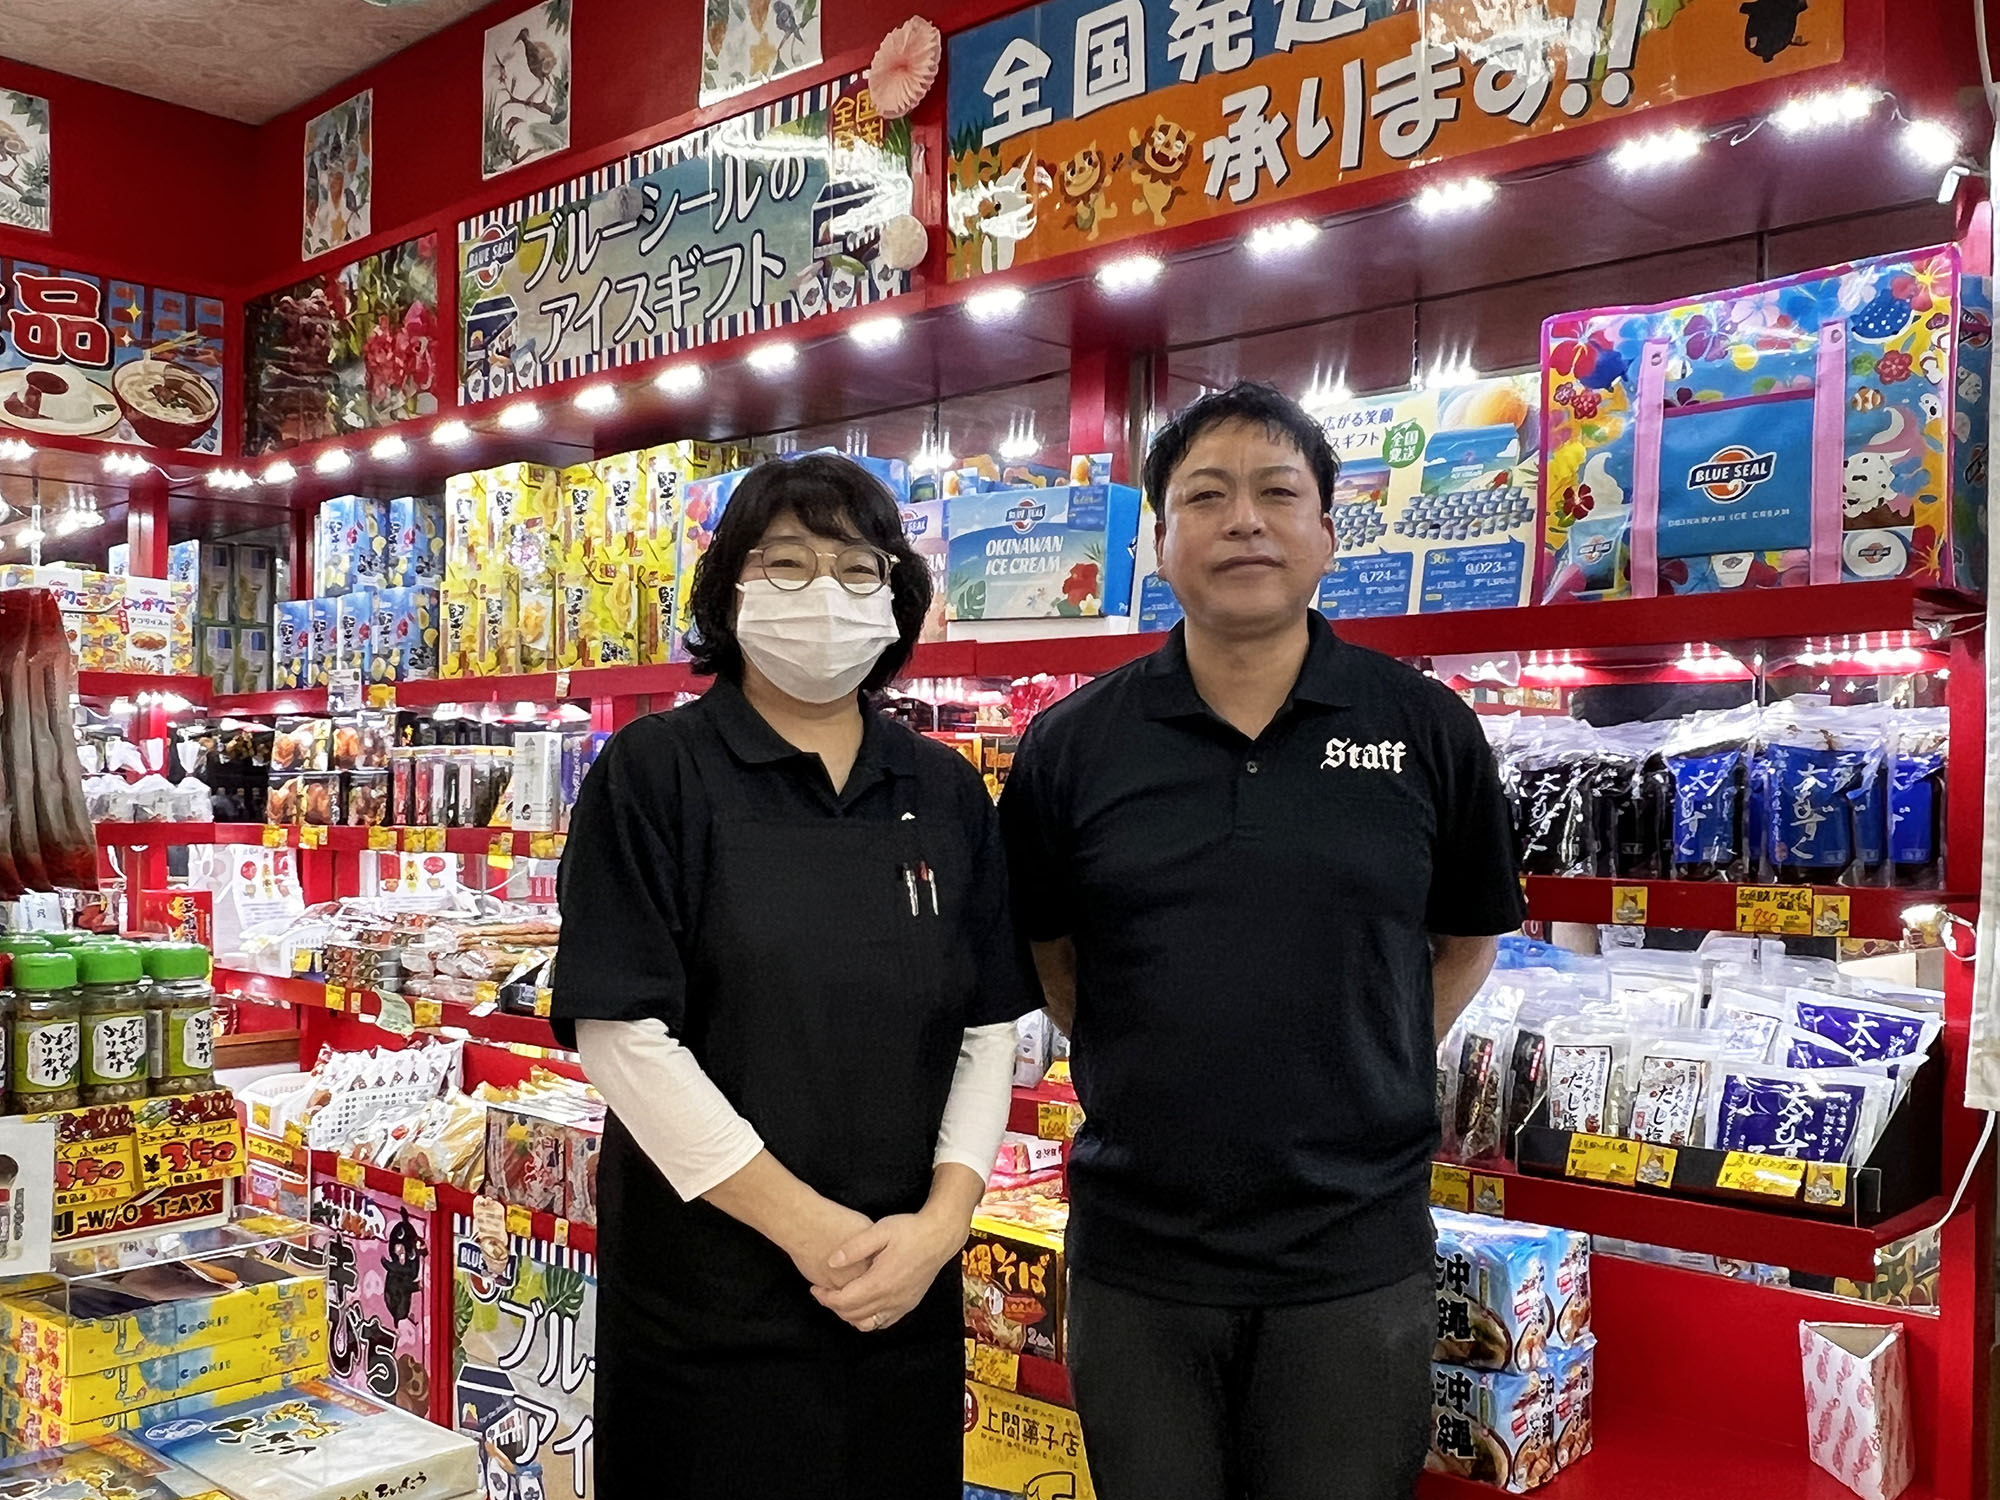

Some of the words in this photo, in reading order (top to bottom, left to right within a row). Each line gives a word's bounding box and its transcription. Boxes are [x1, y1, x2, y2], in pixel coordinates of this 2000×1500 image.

[523, 154, 808, 291] ブルーシールの
[0, 272, 113, 368] 品
[538, 231, 787, 364] アイスギフト
[1694, 466, 1729, 483] BLUE
[1733, 460, 1769, 478] SEAL
[1729, 511, 1749, 522] ICE
[985, 535, 1064, 557] OKINAWAN
[985, 558, 1010, 576] ICE
[1010, 555, 1063, 575] CREAM
[1320, 737, 1407, 774] Staff
[1790, 763, 1836, 860] 太もずく
[156, 1192, 213, 1217] TAX
[460, 1246, 485, 1270] BLUE
[961, 1242, 1051, 1298] 縄そば
[1435, 1252, 1474, 1341] 沖縄
[498, 1297, 596, 1394] ブル
[981, 1406, 1081, 1457] 上間菓子店
[1435, 1370, 1477, 1459] 沖縄
[512, 1394, 595, 1498] アイ
